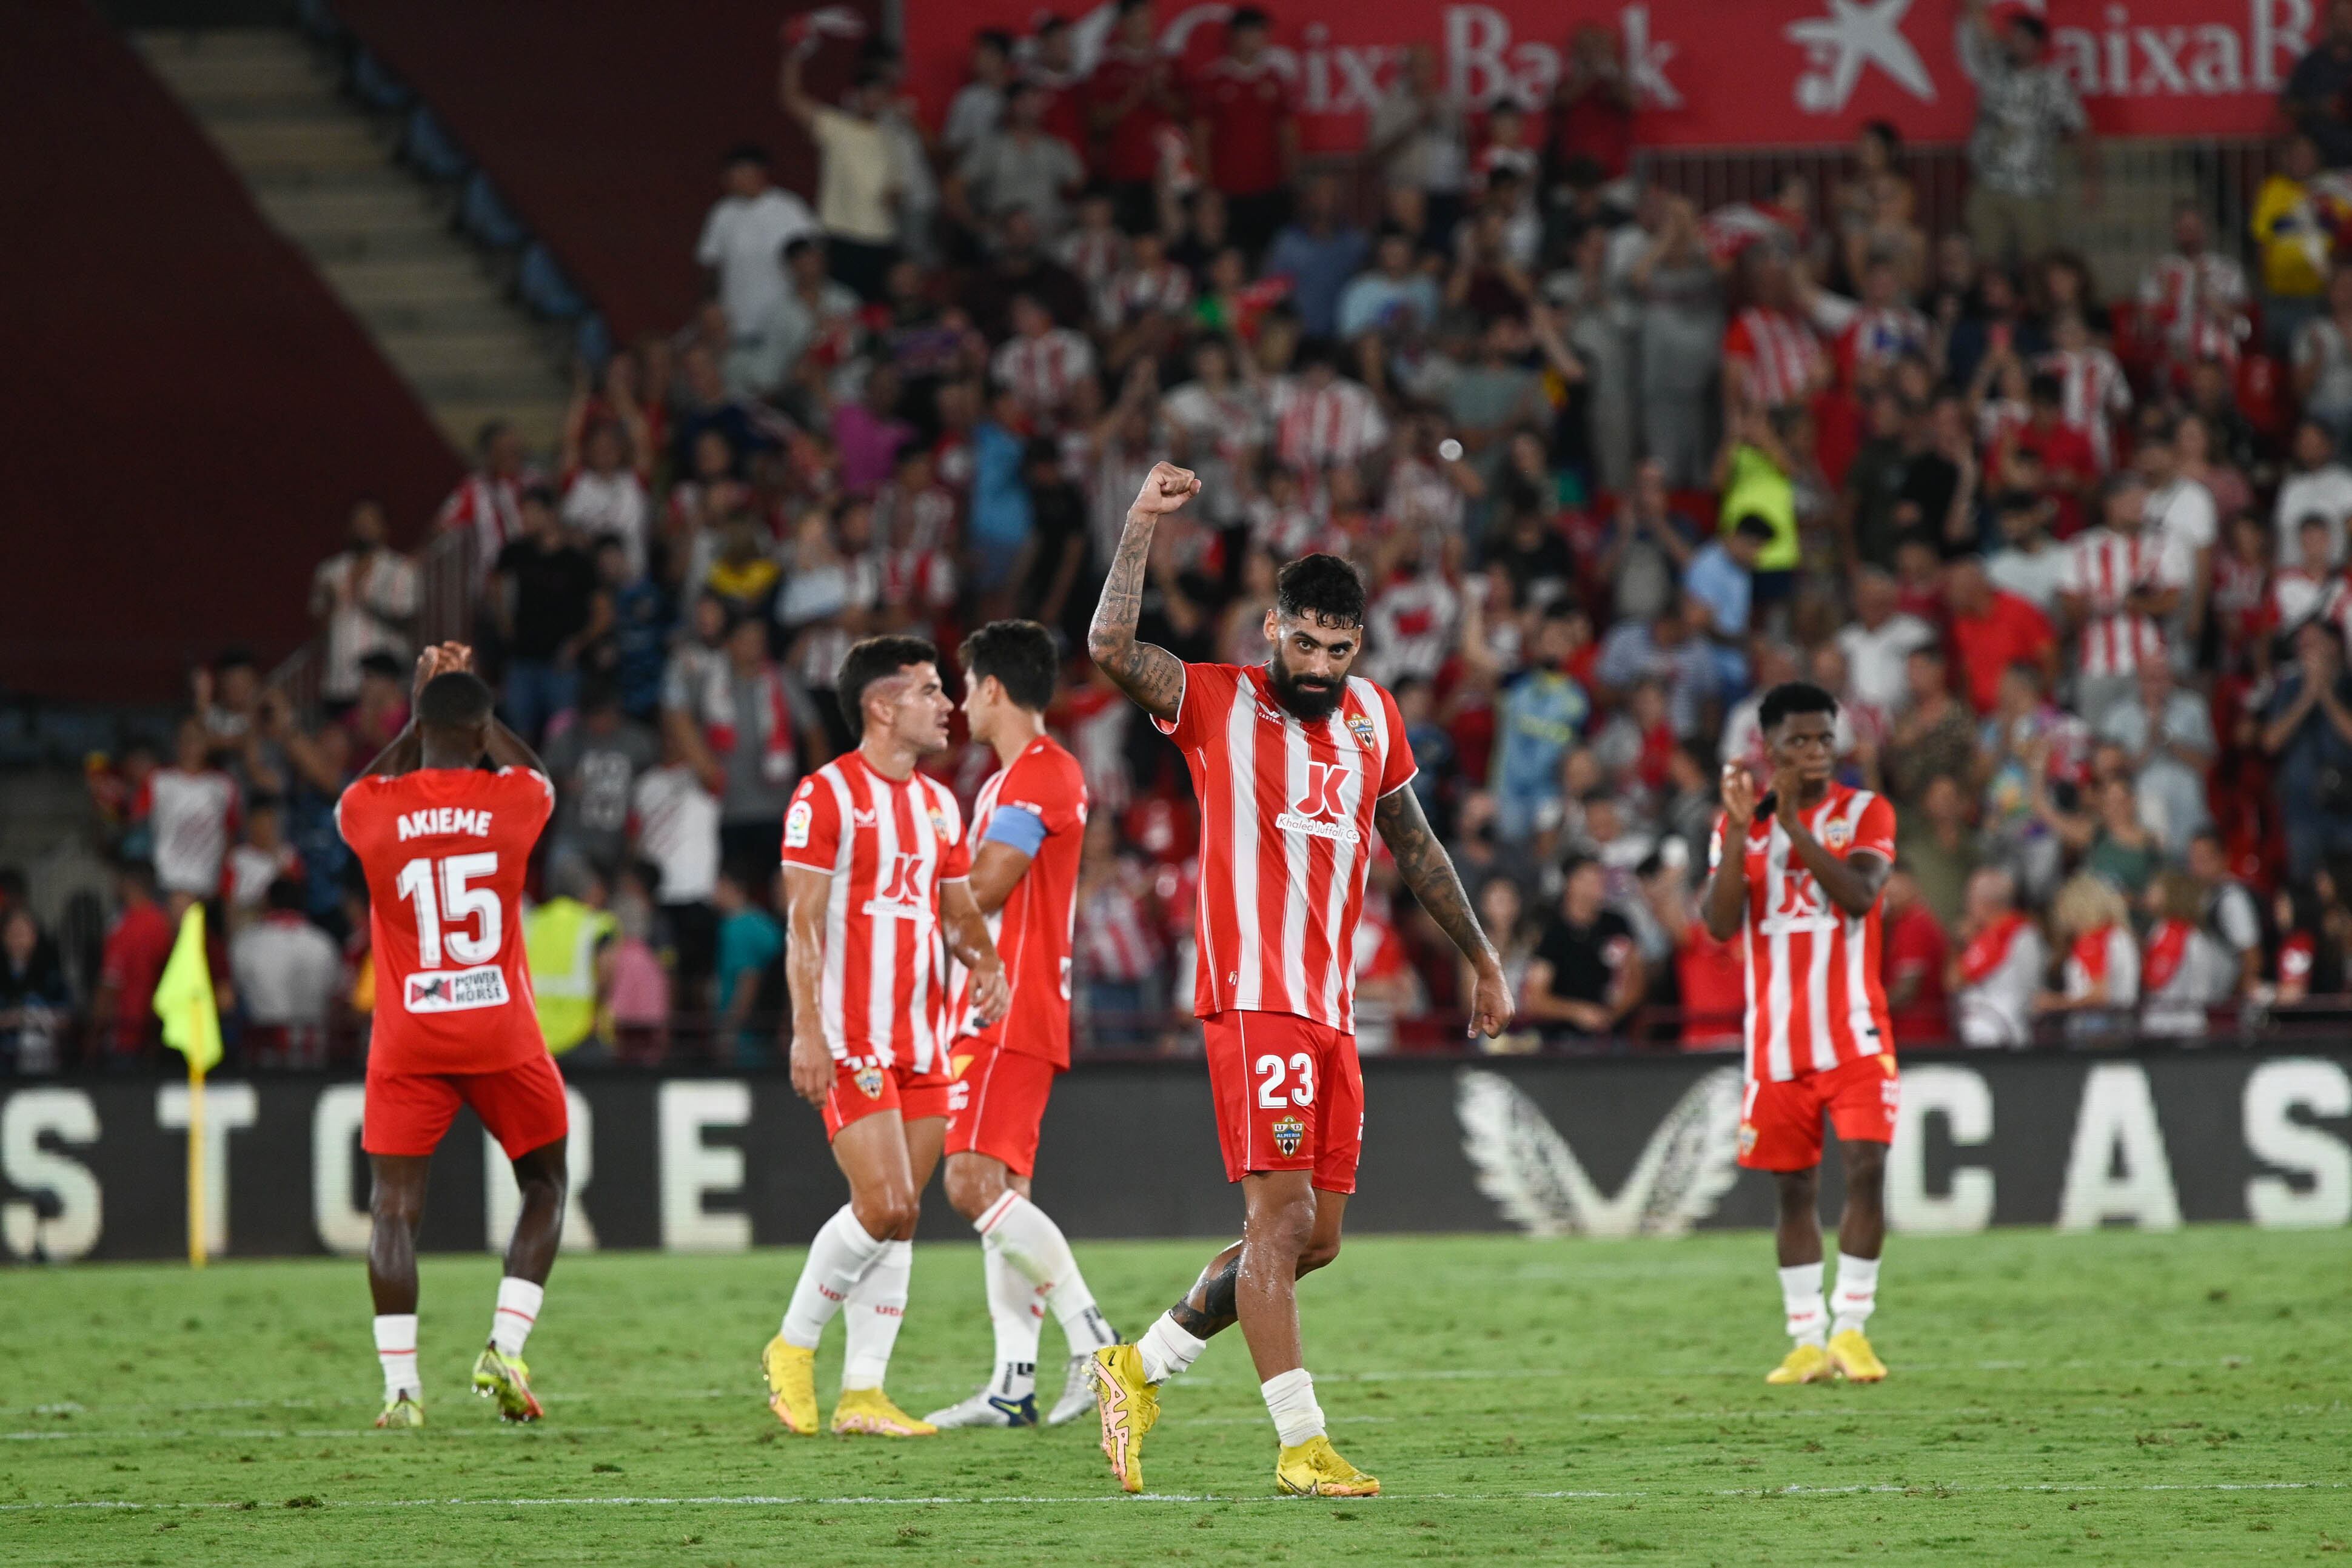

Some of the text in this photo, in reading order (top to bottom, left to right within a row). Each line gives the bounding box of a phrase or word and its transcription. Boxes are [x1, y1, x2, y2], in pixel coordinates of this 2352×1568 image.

[1295, 763, 1351, 816] JK
[397, 808, 492, 842] AKIEME
[1279, 816, 1359, 840] Khaled Juffali Co.
[882, 856, 924, 898] JK
[396, 851, 502, 968] 15
[456, 987, 503, 1003] HORSE
[1256, 1053, 1314, 1109] 23
